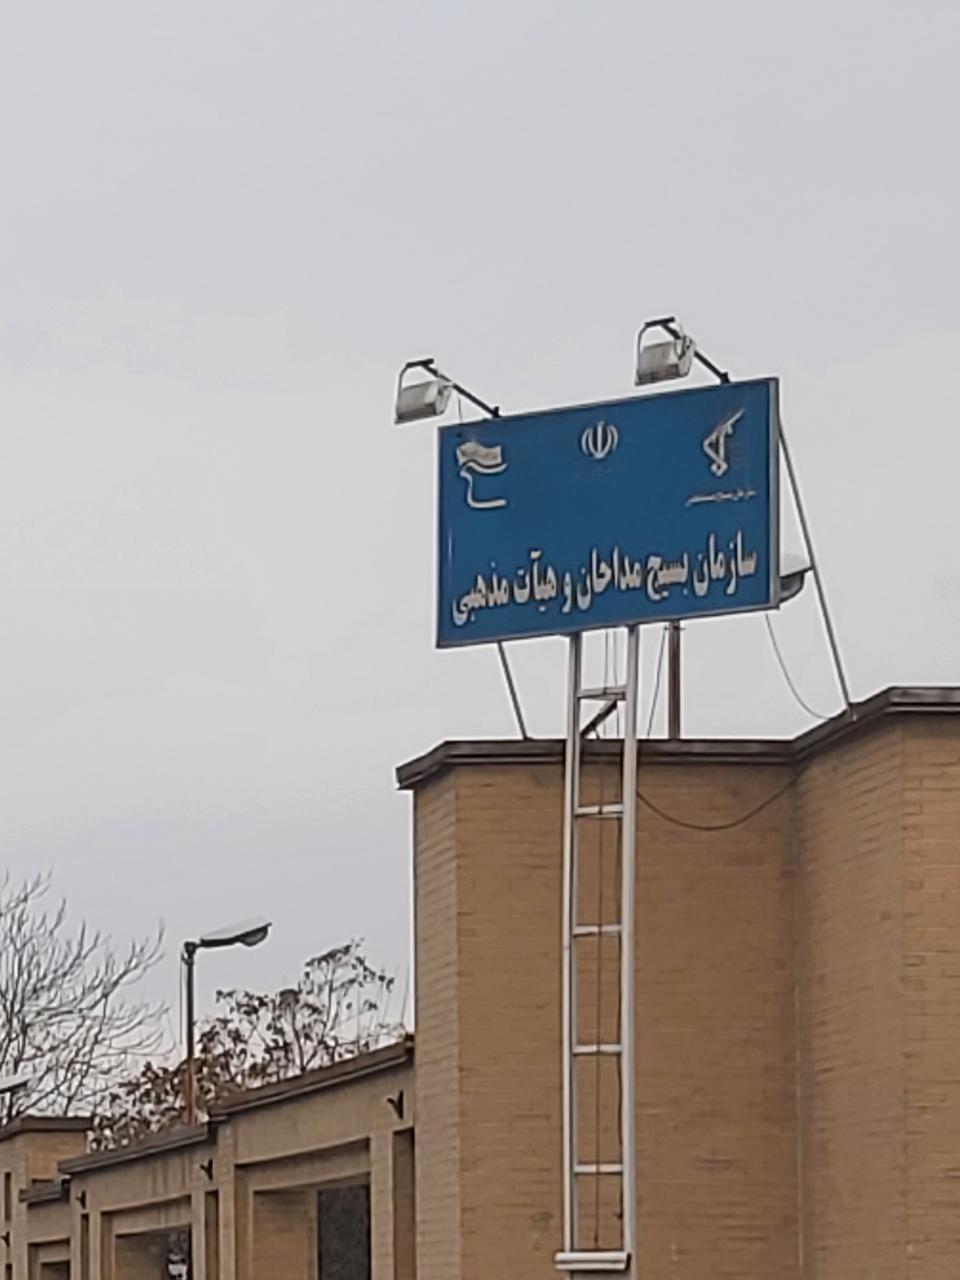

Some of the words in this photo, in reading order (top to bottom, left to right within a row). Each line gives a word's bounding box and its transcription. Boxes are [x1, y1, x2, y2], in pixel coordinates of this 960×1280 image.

[451, 560, 509, 627] مذهبی
[561, 571, 573, 614] و
[576, 545, 641, 611] مداحان
[646, 552, 689, 601] بسیج
[692, 529, 757, 597] سازمان
